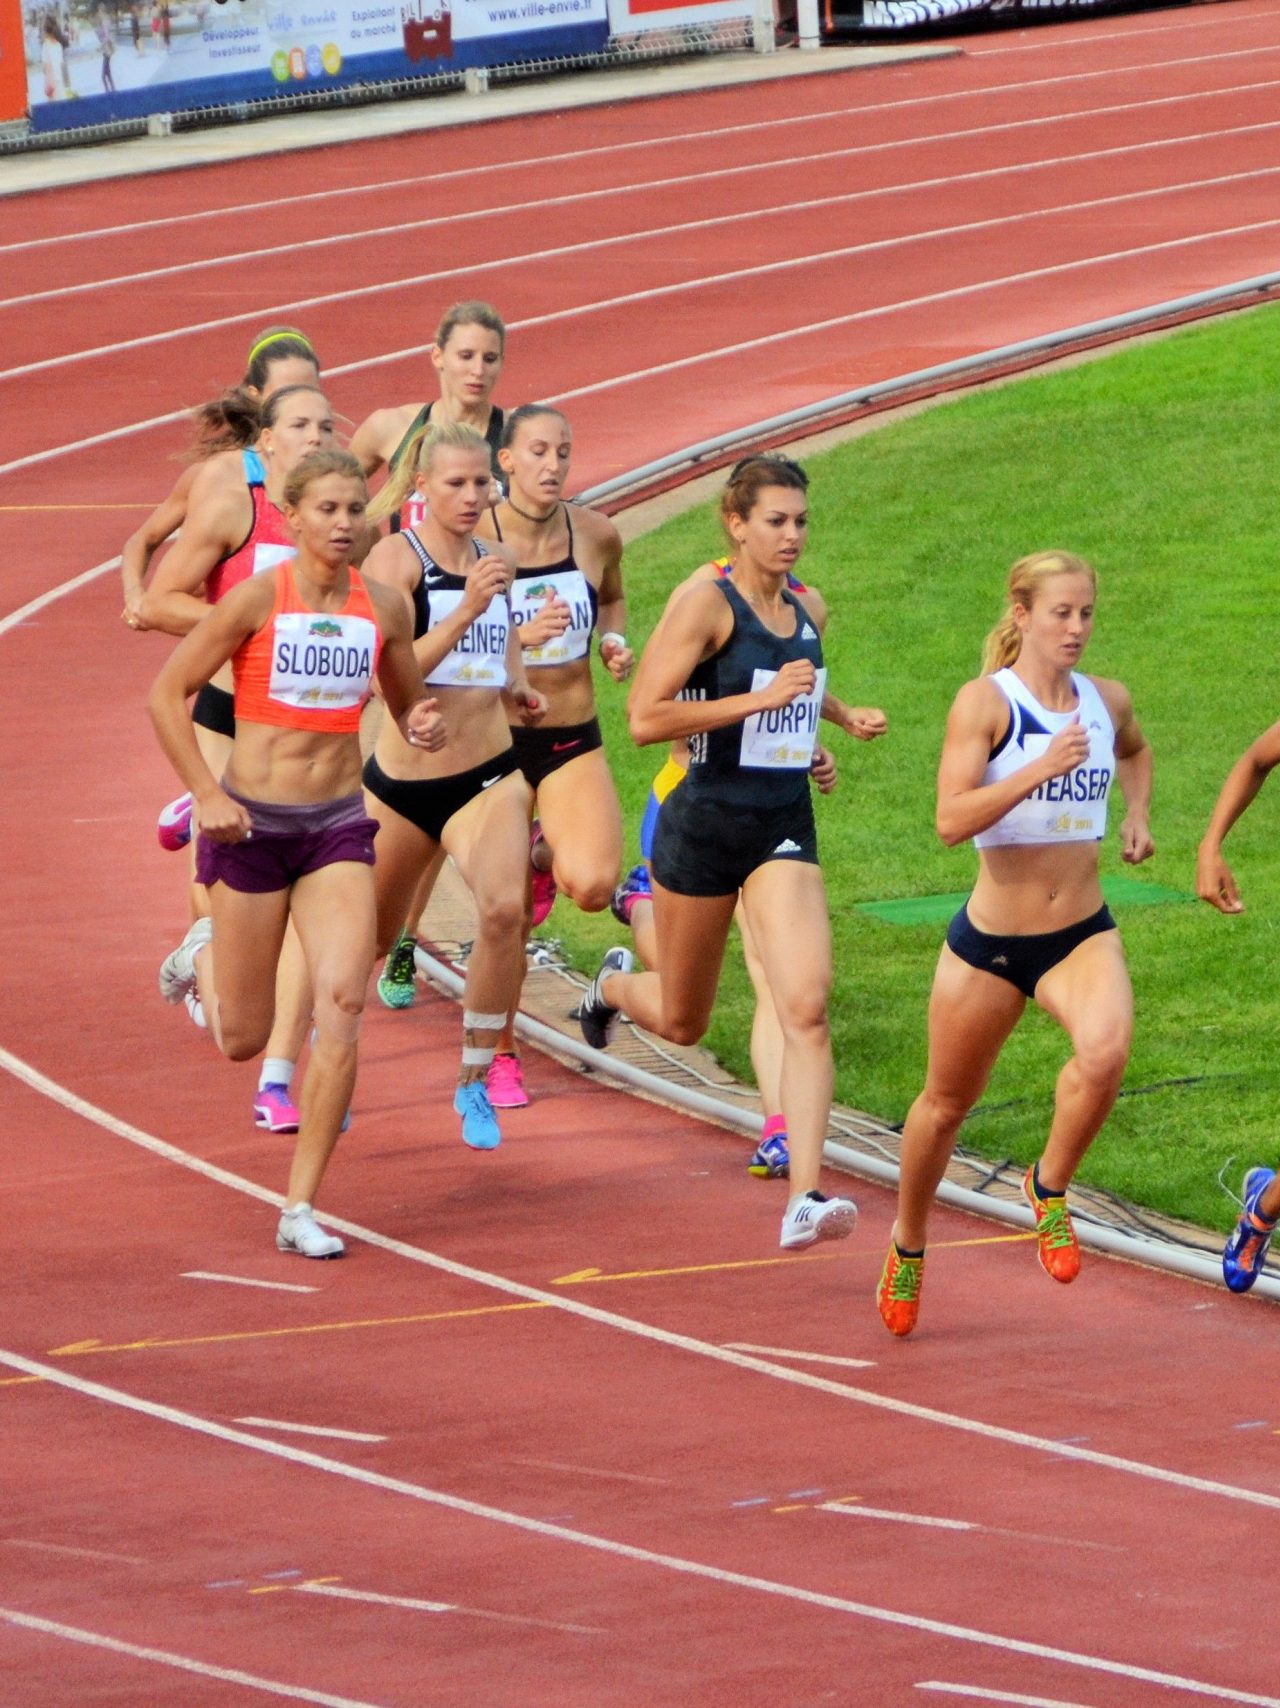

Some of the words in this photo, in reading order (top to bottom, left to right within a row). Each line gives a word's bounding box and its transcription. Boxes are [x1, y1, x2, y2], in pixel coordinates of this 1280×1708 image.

[487, 0, 592, 22] www.ville-envie.fr
[452, 622, 507, 655] EINER
[275, 641, 371, 679] SLOBODA
[1026, 766, 1112, 802] EASER
